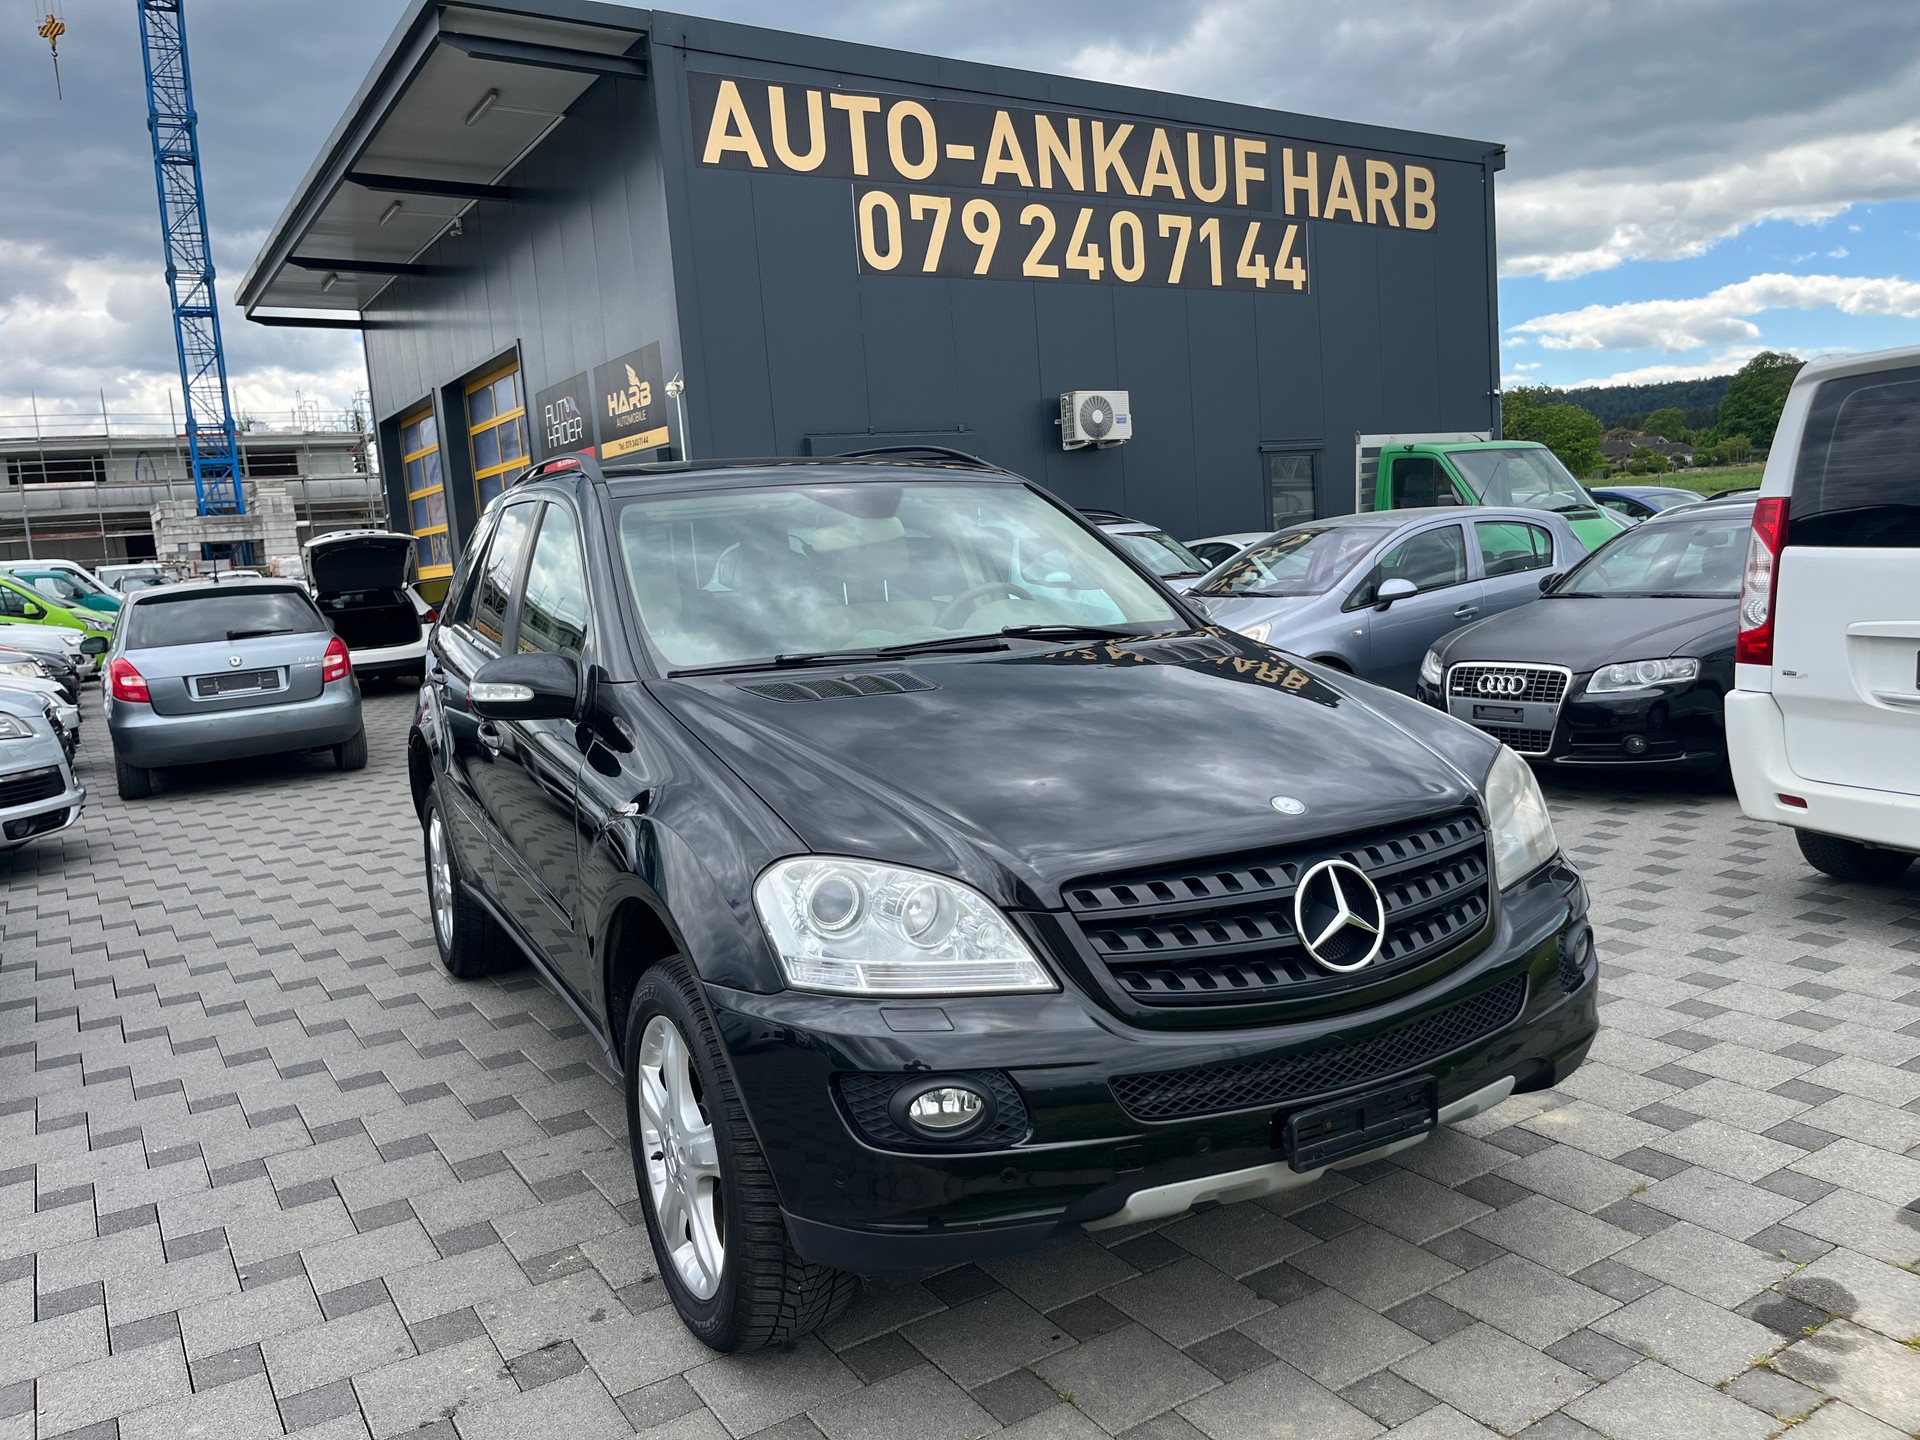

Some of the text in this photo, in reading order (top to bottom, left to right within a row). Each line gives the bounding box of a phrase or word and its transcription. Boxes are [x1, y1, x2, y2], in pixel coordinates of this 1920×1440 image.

[703, 80, 1436, 230] AUTO-ANKAUF HARB
[859, 191, 1001, 275] 079
[1020, 204, 1145, 282] 240
[607, 381, 652, 417] HARB
[616, 410, 647, 428] AUTOMOBILE
